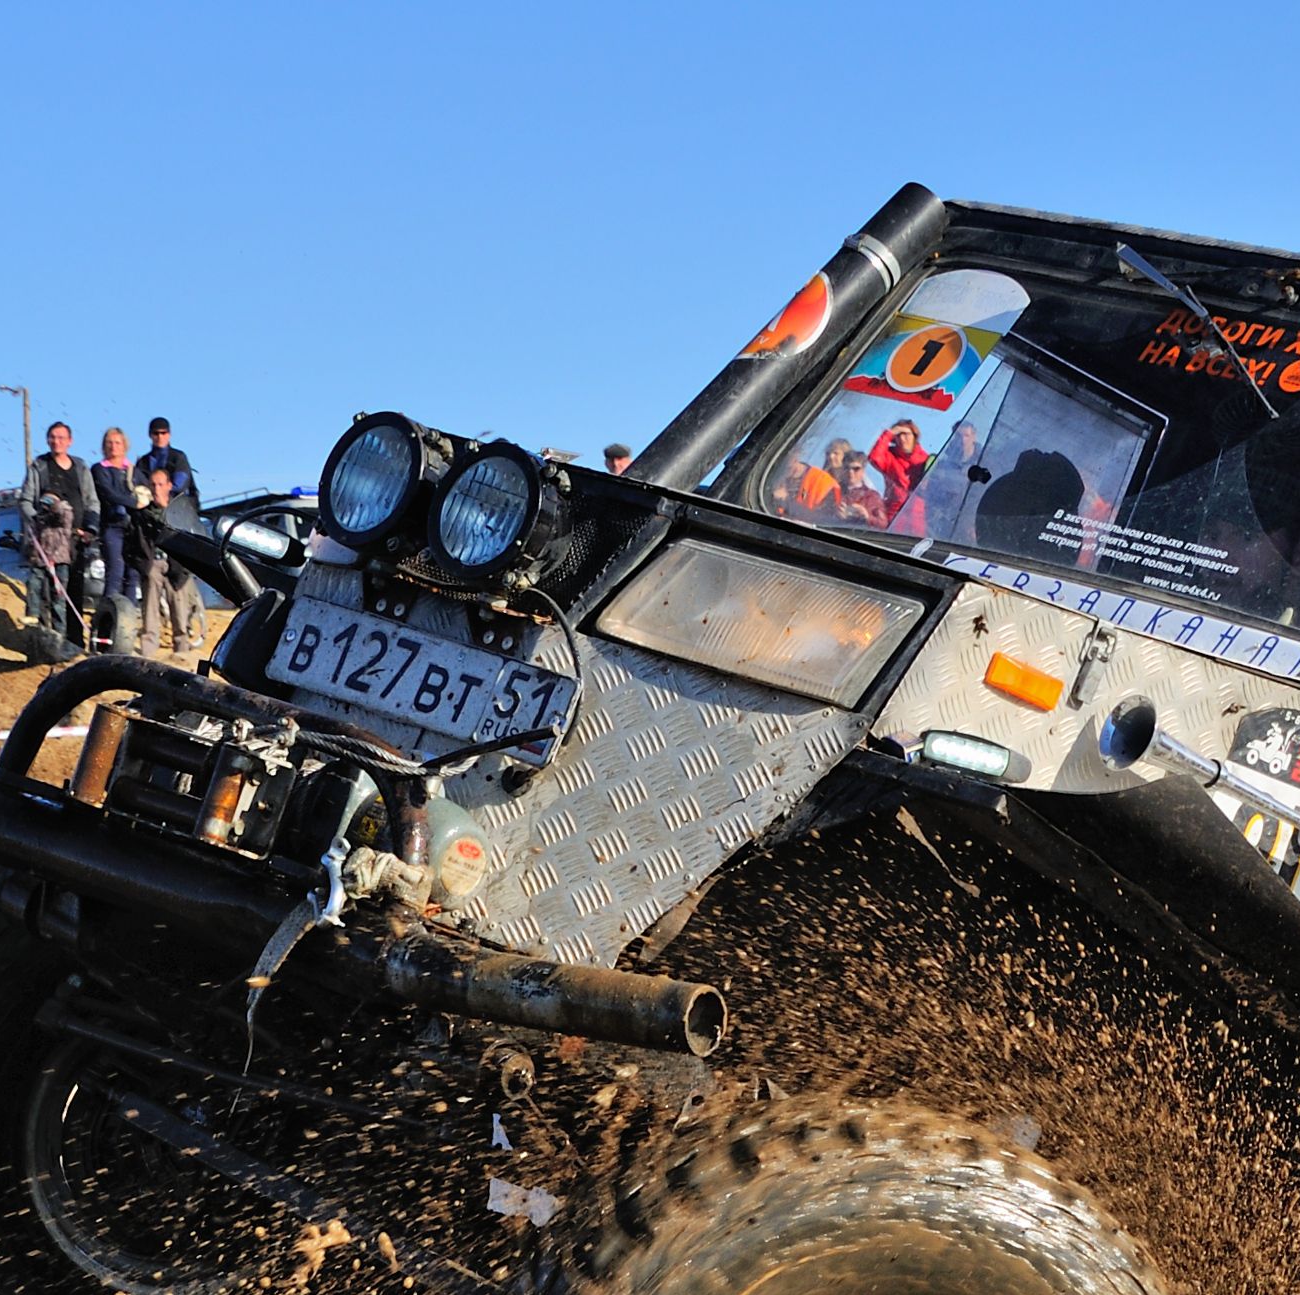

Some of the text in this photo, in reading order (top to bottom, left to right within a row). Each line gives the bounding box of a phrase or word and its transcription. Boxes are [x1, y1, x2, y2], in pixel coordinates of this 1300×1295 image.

[909, 339, 946, 377] 1
[1138, 340, 1181, 367] НА
[1130, 540, 1160, 558] когда
[1184, 541, 1229, 559] главное
[1141, 556, 1184, 574] полный
[493, 669, 557, 729] 51
